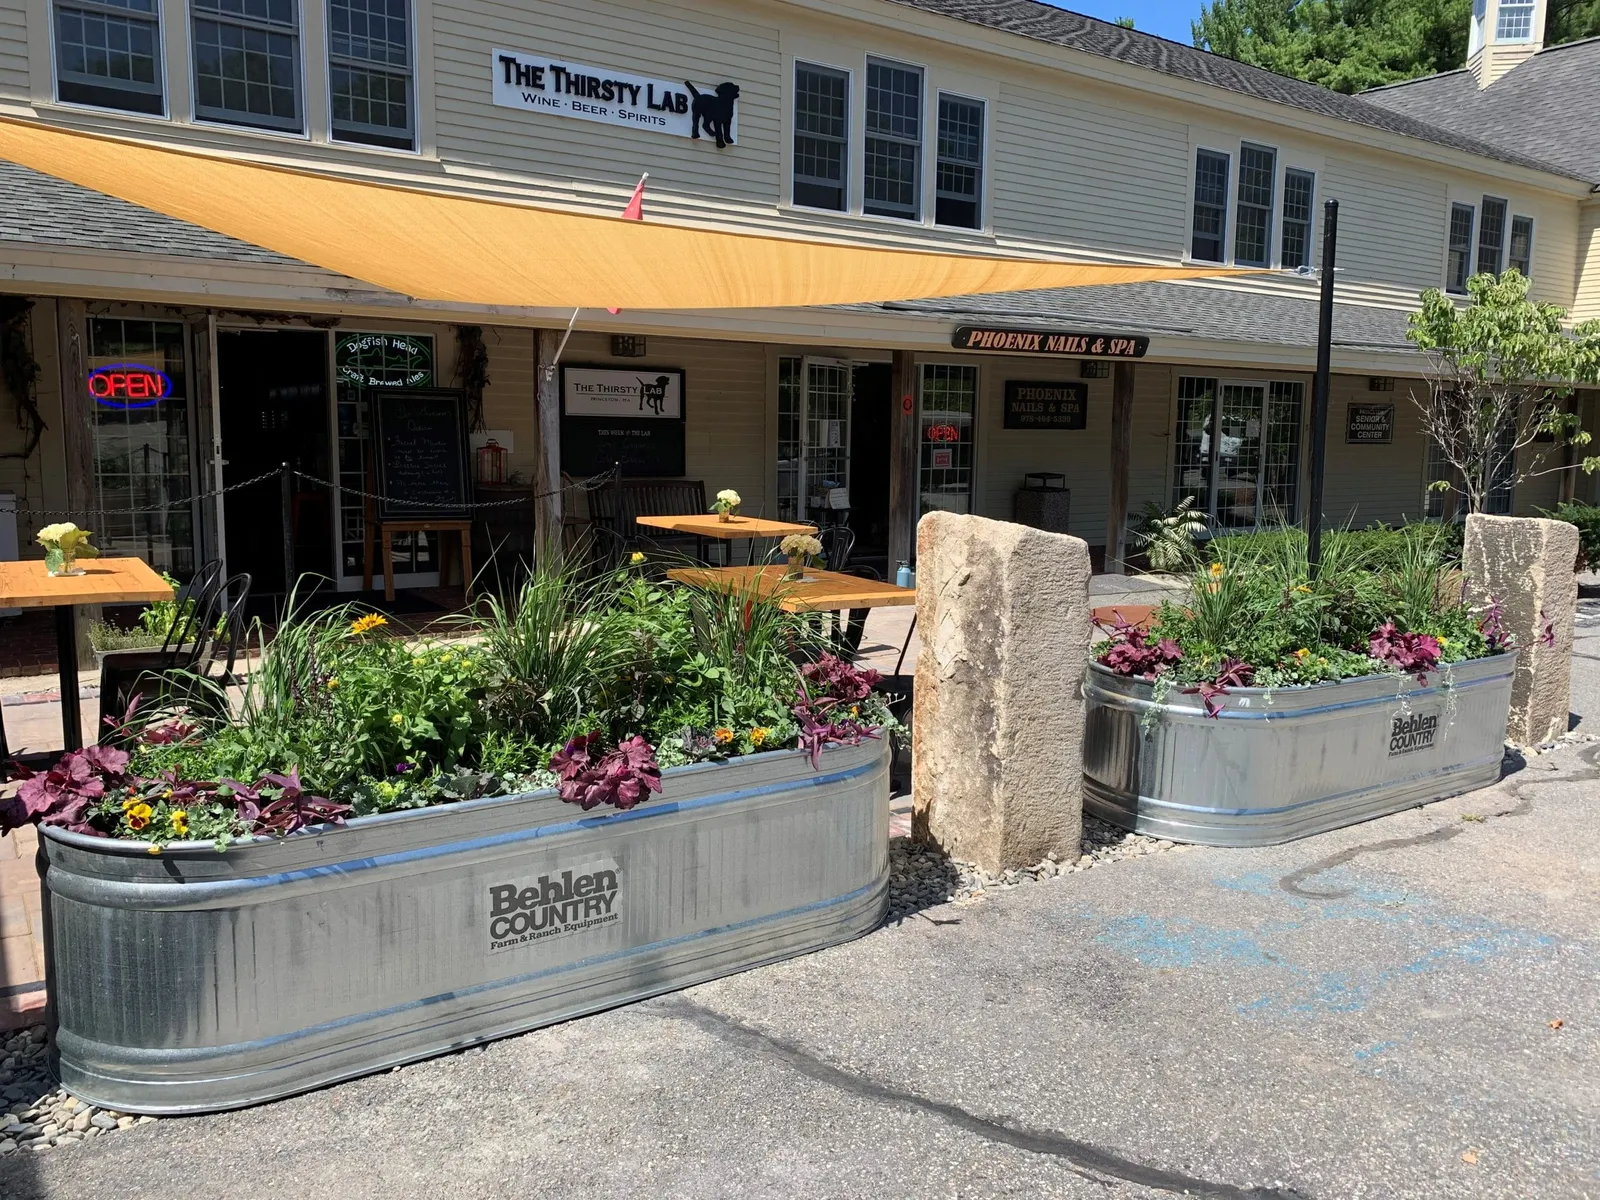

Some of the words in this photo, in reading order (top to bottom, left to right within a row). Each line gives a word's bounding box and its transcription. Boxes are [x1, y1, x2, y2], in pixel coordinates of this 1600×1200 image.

[499, 54, 545, 90] THE
[549, 64, 642, 106] THIRSTY
[647, 83, 688, 114] LAB
[522, 92, 560, 108] WINE
[572, 101, 608, 116] BEER
[618, 108, 666, 126] SPIRITS
[346, 336, 388, 353] Dogfish
[392, 338, 418, 355] Head
[966, 330, 1044, 350] PHOENIX
[1044, 334, 1090, 353] NAILS
[1091, 338, 1105, 353] &
[1108, 338, 1136, 355] SPA
[88, 373, 163, 397] OPEN
[342, 365, 364, 383] Craft
[368, 376, 404, 386] Brewed
[574, 382, 594, 392] THE
[596, 384, 638, 394] THIRSTY
[644, 387, 662, 395] LAB
[1018, 388, 1076, 400] PHOENIX
[1011, 402, 1044, 412] NAILS
[1048, 403, 1056, 412] &
[1060, 404, 1080, 412] SPA
[1351, 423, 1389, 431] COMMUNITY
[1356, 415, 1380, 423] SENIOR
[927, 425, 959, 441] OPEN
[1391, 713, 1437, 737] Behlen
[1390, 728, 1436, 751] COUNTRY
[490, 870, 618, 918] Behlen
[490, 890, 618, 940] COUNTRY
[490, 938, 518, 950] Farm
[529, 926, 561, 940] Ranch
[564, 912, 618, 932] Equipment
